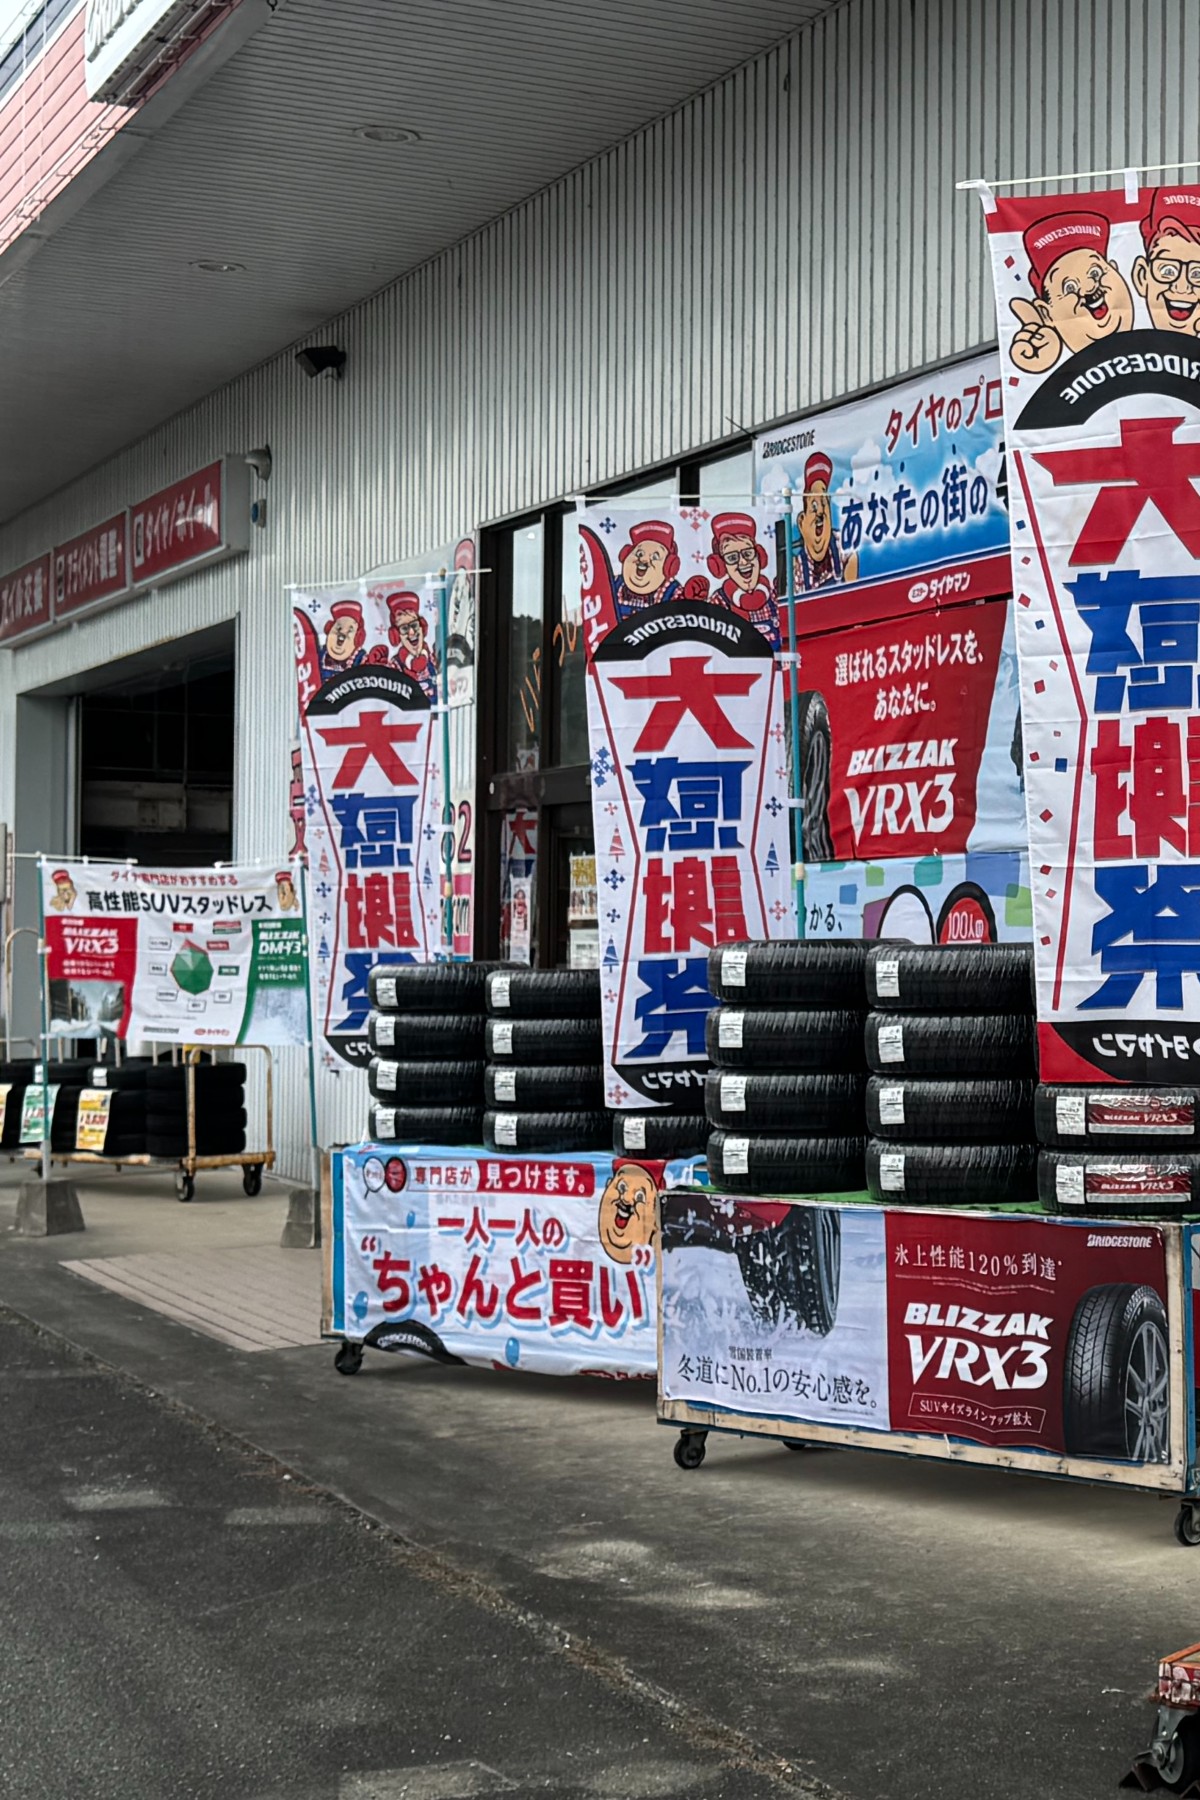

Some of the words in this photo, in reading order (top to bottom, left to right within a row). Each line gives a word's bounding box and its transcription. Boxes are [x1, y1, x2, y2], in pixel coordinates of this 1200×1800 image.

[762, 428, 815, 459] BRIDGESTONE
[929, 571, 971, 601] タイヤマン
[834, 629, 984, 686] 選ばれるスタッドレスを、
[873, 681, 936, 721] あなたに。
[846, 738, 959, 777] BLIZZAK
[844, 772, 956, 847] VRX3
[86, 889, 273, 915] 高性能SUVスタッドレス
[793, 902, 843, 932] かる、
[64, 938, 120, 959] VRX3
[1143, 1112, 1178, 1123] VRX3
[414, 1166, 473, 1186] 専門店が
[485, 1162, 586, 1193] 見つけます。
[438, 1206, 566, 1248] 一人一人の
[1086, 1233, 1153, 1248] BRIDGESTONE
[903, 1302, 1054, 1340] BLIZZAK
[904, 1333, 1051, 1391] VRX3
[677, 1353, 877, 1409] 冬道にNo.1の安心感を。
[919, 1399, 1033, 1427] SUVサイズラインアップ拡大
